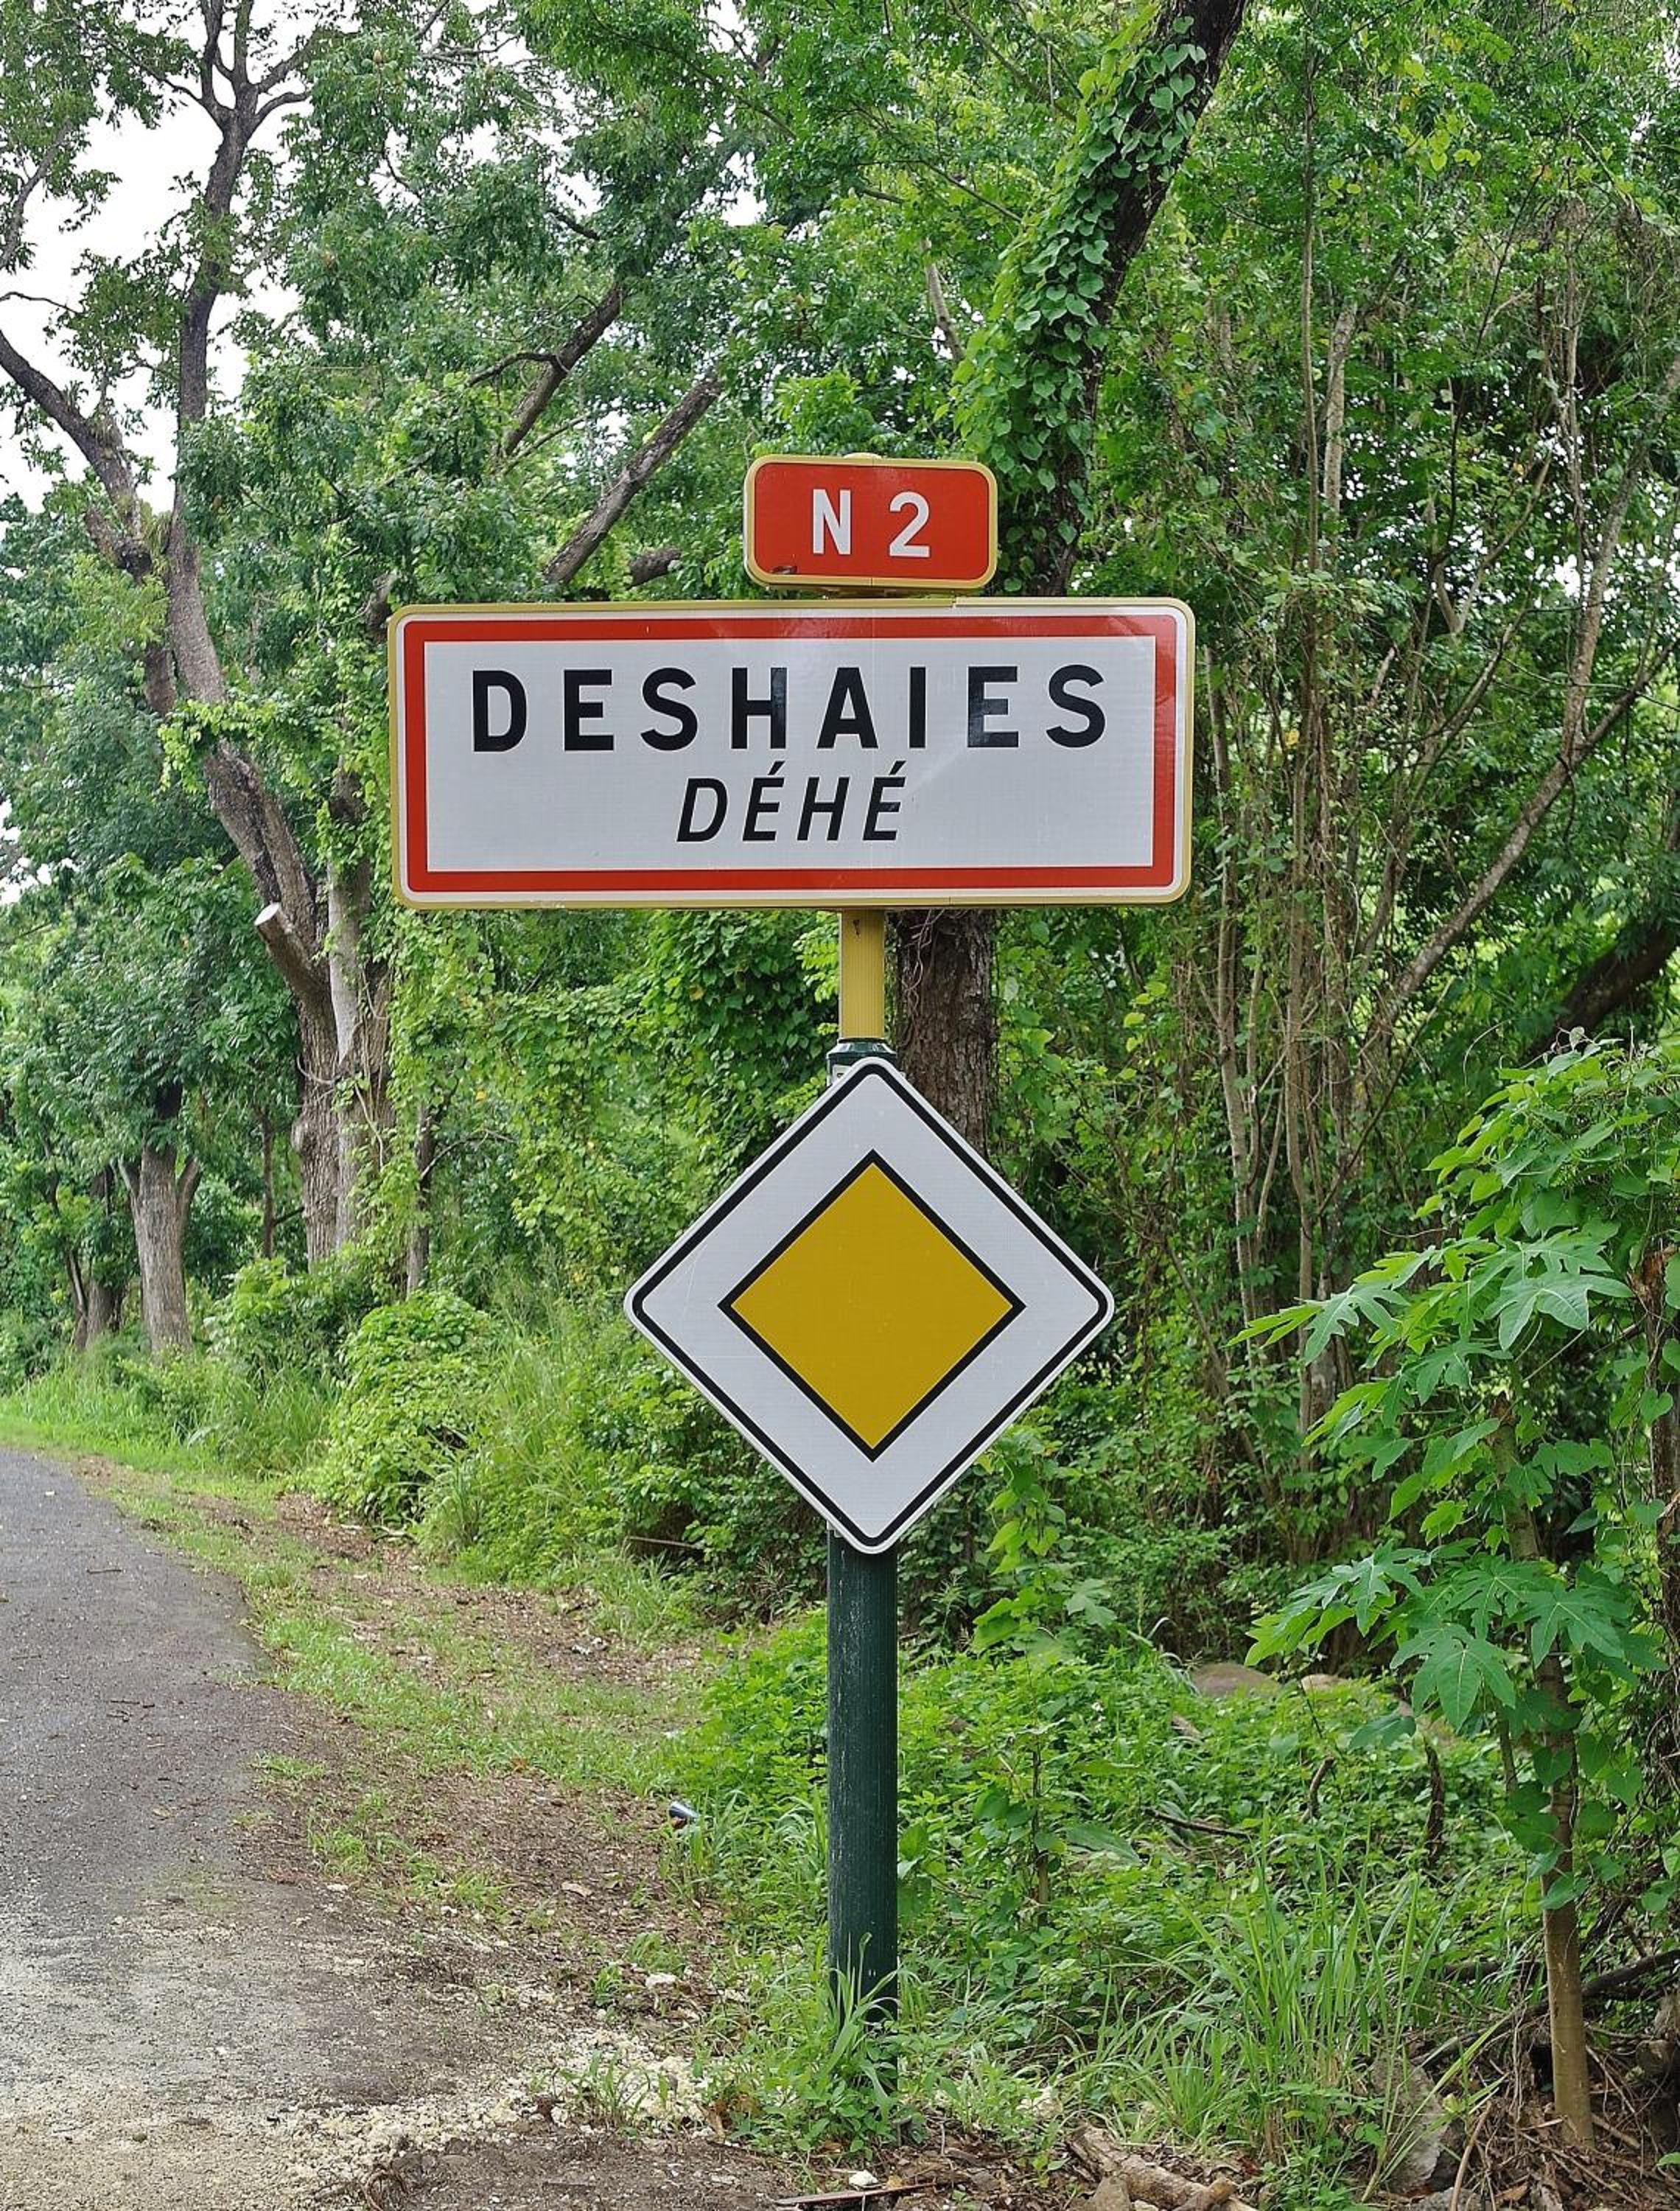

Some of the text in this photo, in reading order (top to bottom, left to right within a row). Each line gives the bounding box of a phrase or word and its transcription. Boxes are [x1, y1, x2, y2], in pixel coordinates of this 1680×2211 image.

[812, 488, 931, 558] N 2
[472, 664, 1107, 752] DESHAIES
[676, 760, 906, 842] DÉHÉ
